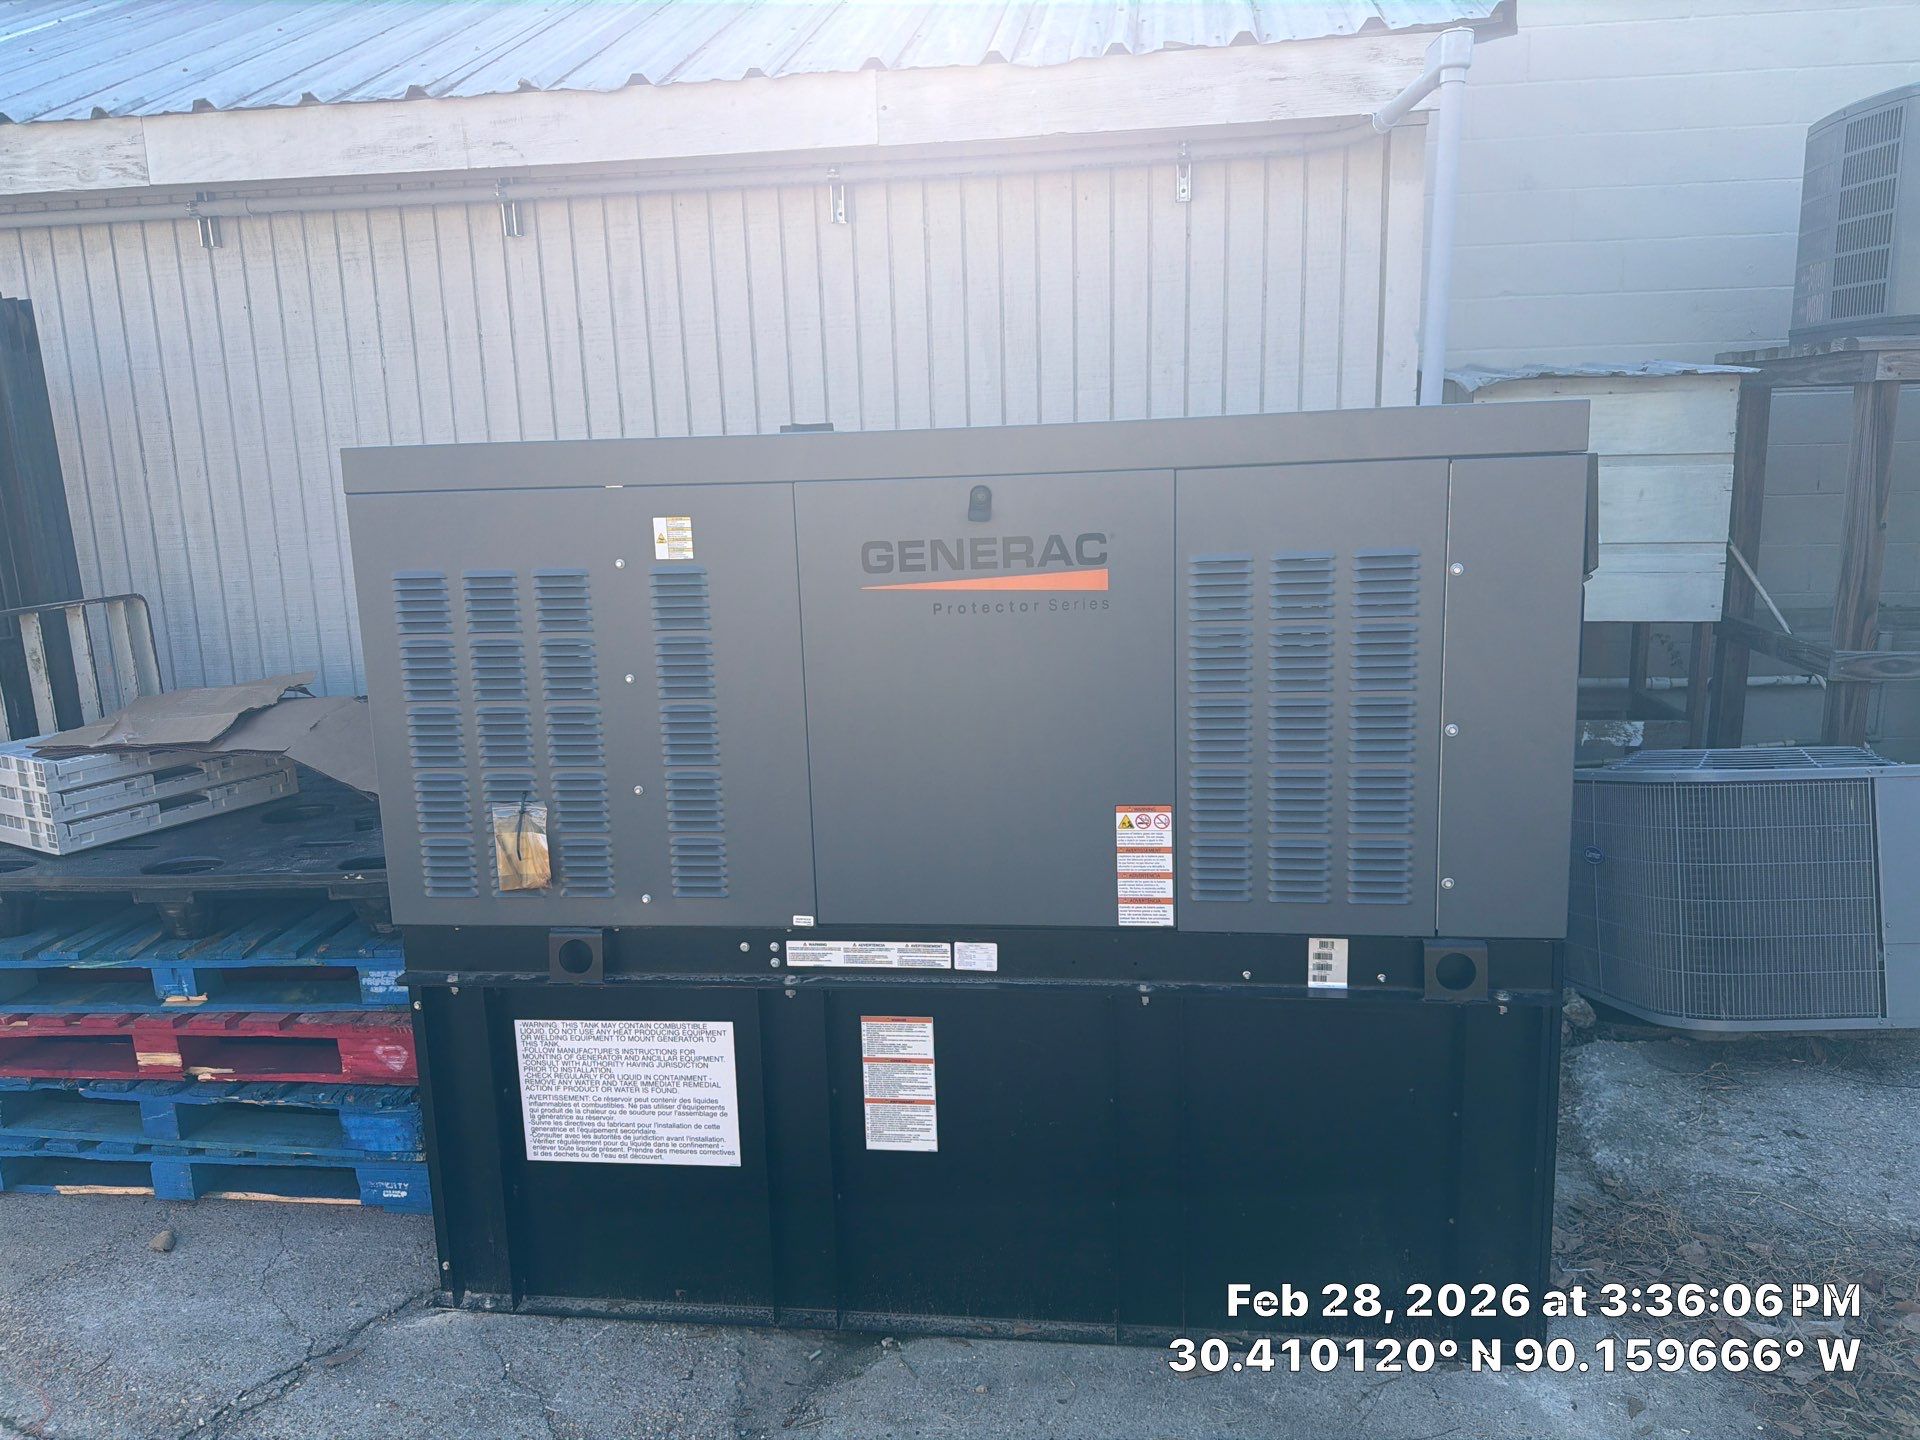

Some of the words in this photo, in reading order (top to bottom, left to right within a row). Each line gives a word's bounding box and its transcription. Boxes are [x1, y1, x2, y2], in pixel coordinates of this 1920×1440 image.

[861, 533, 1107, 574] GENERAC
[933, 600, 1039, 615] Protector
[1049, 598, 1110, 611] Series
[674, 1110, 717, 1118] l'assemblage
